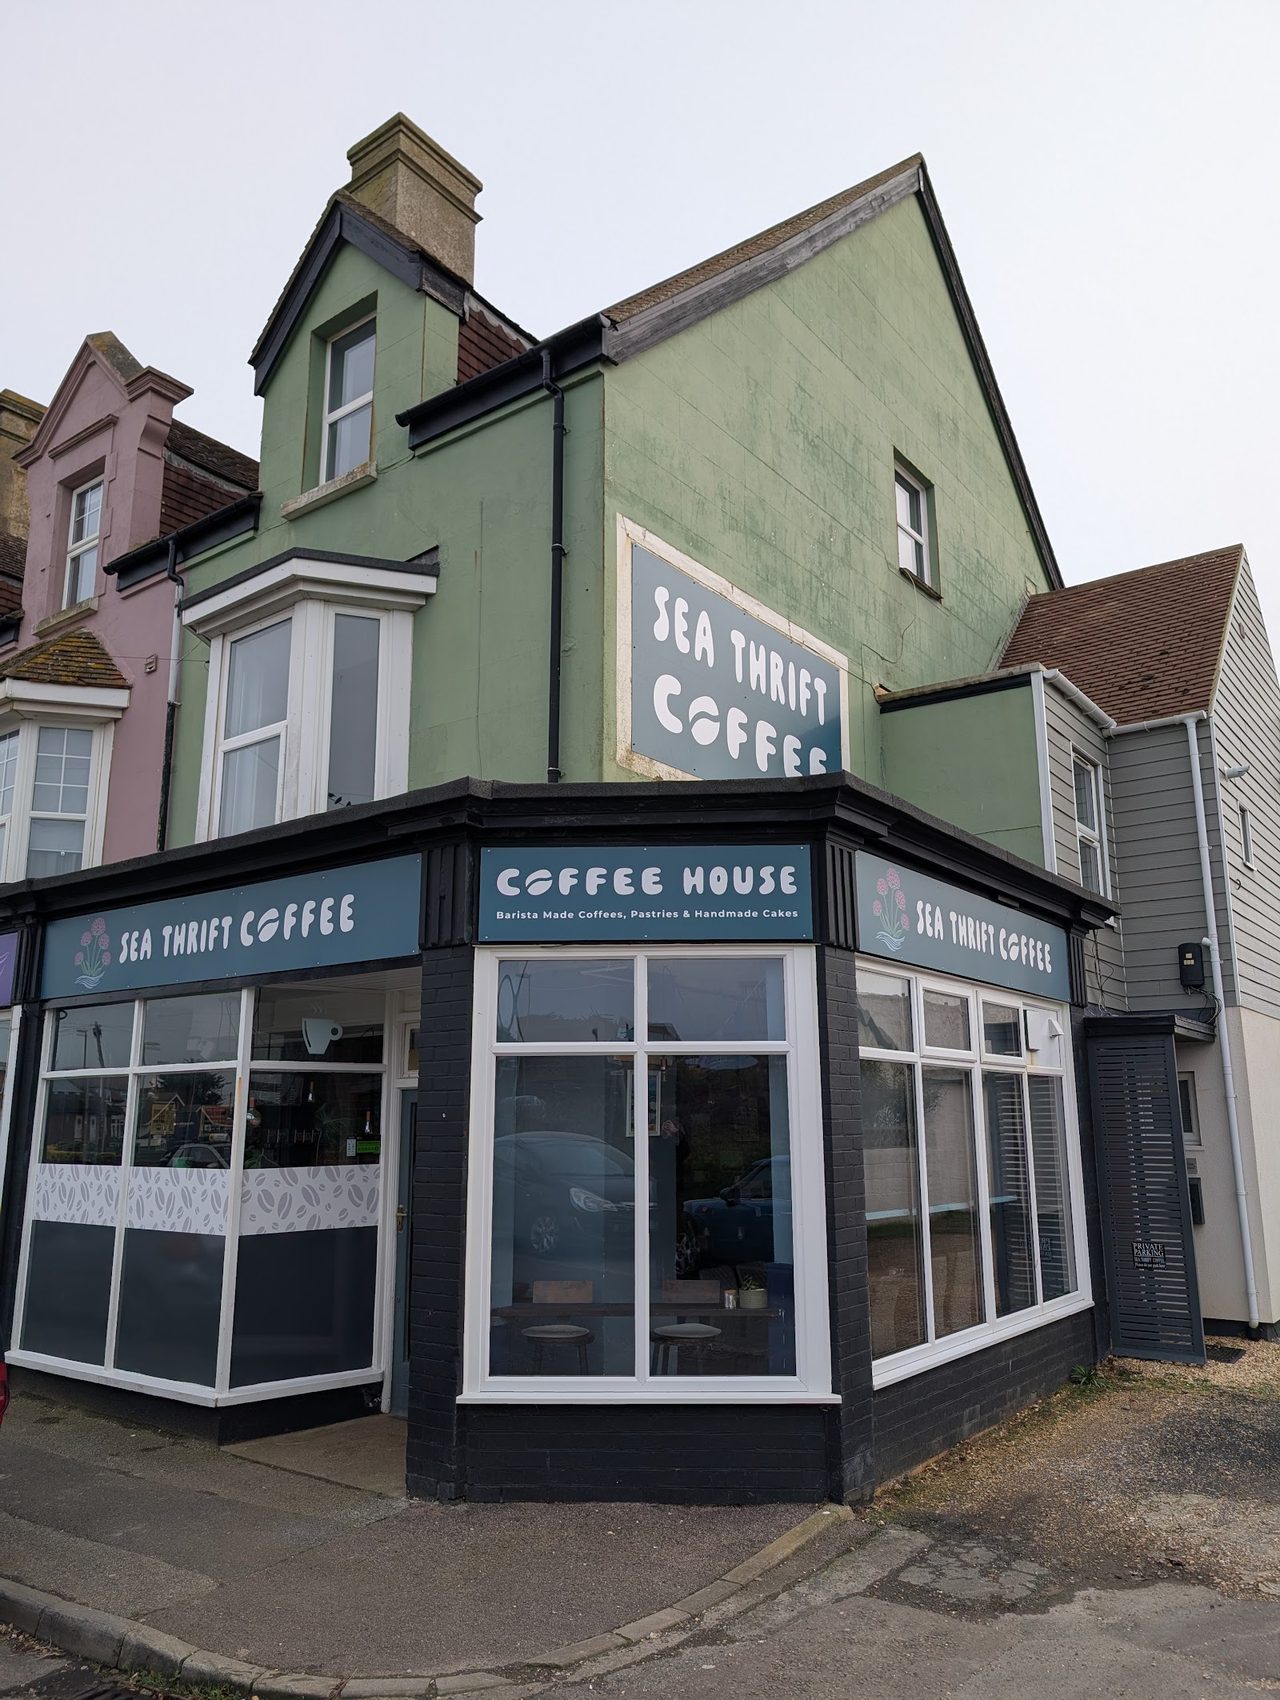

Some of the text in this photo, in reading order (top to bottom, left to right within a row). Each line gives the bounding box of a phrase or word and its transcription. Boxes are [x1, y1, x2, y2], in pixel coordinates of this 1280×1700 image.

[653, 586, 827, 726] SEA THRIFT
[683, 865, 798, 895] HOUSE
[496, 909, 798, 920] Barista Made Coffees, Pastries & Handmade Cakes
[916, 900, 944, 940] SEA
[949, 911, 995, 956] THRIFT
[119, 928, 152, 964] SEA
[162, 915, 233, 957] THRIFT
[1132, 1242, 1164, 1250] PRIVATE
[1133, 1249, 1164, 1257] PARKING
